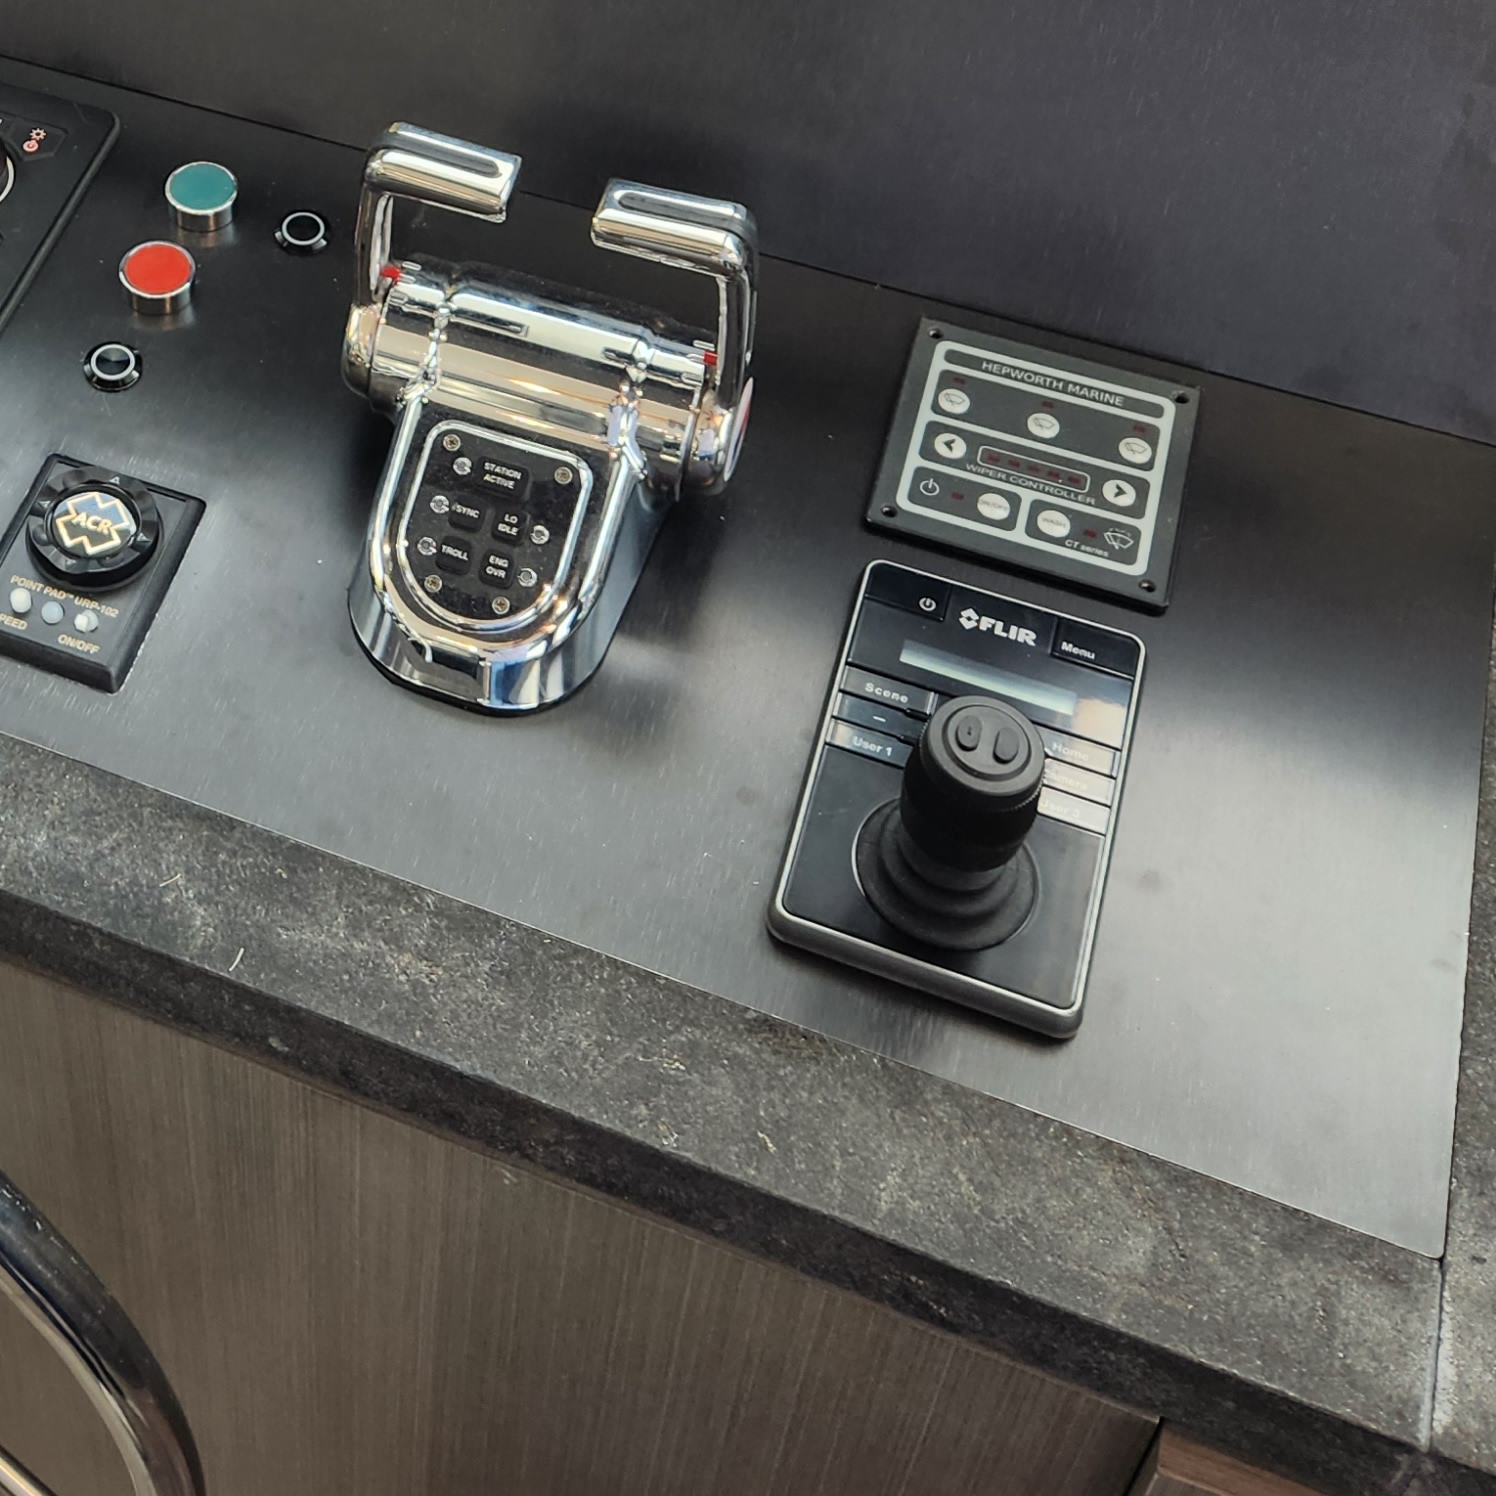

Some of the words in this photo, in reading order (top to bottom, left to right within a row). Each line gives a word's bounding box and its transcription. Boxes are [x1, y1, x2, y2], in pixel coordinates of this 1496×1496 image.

[981, 360, 1063, 391] HEPWORTH
[1067, 382, 1125, 407] MARINE
[484, 461, 522, 481] STATION
[483, 473, 516, 489] ACTIVE
[965, 463, 1008, 482] WIPER
[1009, 474, 1096, 506] CONTROLLER
[455, 502, 480, 519] SYNC
[504, 513, 518, 524] LO
[71, 510, 114, 535] ACR
[497, 523, 519, 536] IDLE
[1042, 517, 1066, 528] WASH
[441, 544, 469, 561] TROLL
[1065, 539, 1079, 548] CT
[1080, 544, 1109, 557] series
[489, 555, 509, 568] ENG
[10, 574, 44, 593] POINT
[74, 596, 119, 618] URP-102
[979, 617, 1037, 647] FLIR
[57, 634, 100, 654] ON/OFF
[1061, 641, 1096, 660] Menu
[865, 682, 909, 703] Scene
[853, 735, 884, 754] User
[1052, 742, 1089, 761] Home
